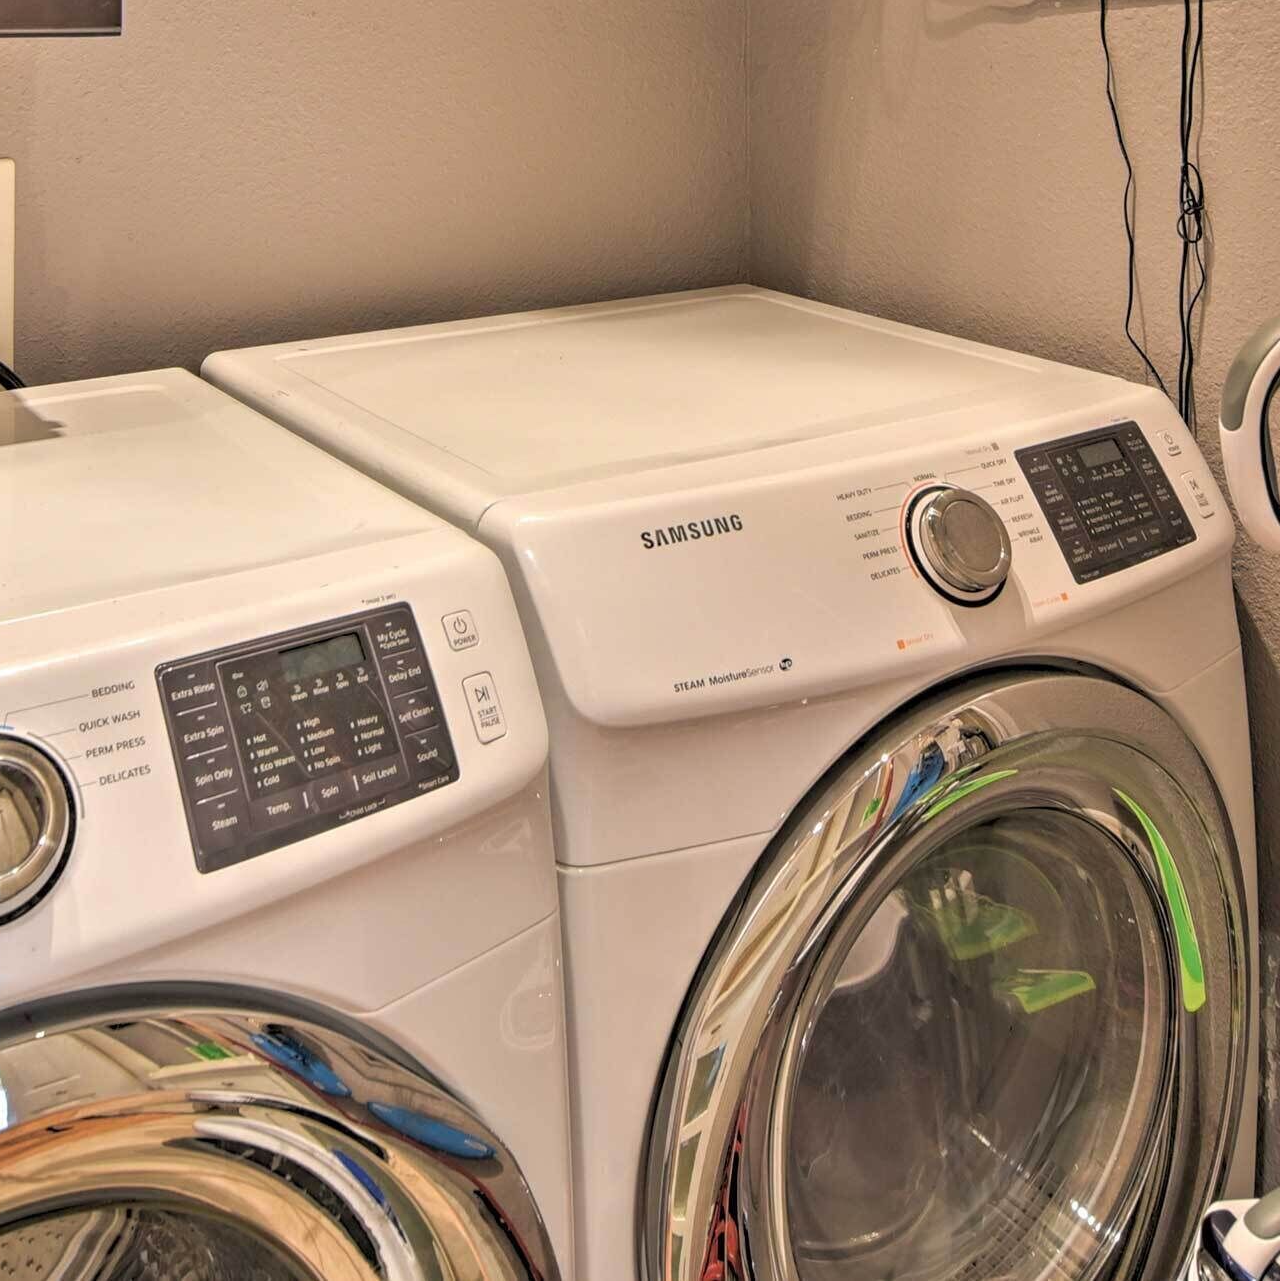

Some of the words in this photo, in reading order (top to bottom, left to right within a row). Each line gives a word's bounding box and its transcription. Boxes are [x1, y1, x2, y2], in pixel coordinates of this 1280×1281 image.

[836, 490, 857, 502] HEAVY
[640, 514, 743, 549] SAMSUNG
[854, 528, 880, 541] SANITIZE
[862, 550, 880, 561] PERM
[881, 546, 898, 556] PRESS
[870, 567, 901, 581] DELICATES
[377, 633, 388, 643] My
[389, 628, 407, 639] Cycle
[453, 635, 476, 646] POWER
[388, 670, 408, 684] Delay
[408, 666, 422, 677] End
[91, 680, 135, 698] BEDDING
[171, 688, 193, 701] Extra
[194, 682, 215, 694] Rinse
[673, 678, 705, 693] STEAM
[399, 710, 412, 723] Self
[477, 705, 497, 718] START
[79, 717, 109, 732] QUICK
[112, 710, 141, 724] WASH
[303, 717, 320, 729] High
[357, 715, 378, 727] Heavy
[480, 718, 500, 729] PAUSE
[184, 731, 206, 743] Extra
[206, 725, 225, 738] Spin
[253, 733, 267, 744] Hot
[307, 728, 335, 742] Medium
[360, 727, 385, 740] Normal
[86, 745, 113, 759] PERM
[116, 736, 146, 751] PRESS
[256, 745, 279, 758] Warm
[310, 746, 325, 756] Low
[364, 742, 382, 755] Light
[314, 760, 325, 770] No
[326, 755, 341, 767] Spin
[417, 749, 438, 763] Sound
[260, 762, 273, 773] Eco
[274, 755, 296, 768] Warm
[99, 764, 151, 786] DELICATES
[195, 772, 214, 787] Spin
[214, 767, 233, 781] Only
[263, 775, 280, 787] Cold
[362, 772, 377, 785] Soil
[378, 765, 397, 780] Level
[321, 785, 339, 799] Spin
[212, 816, 238, 831] Steam
